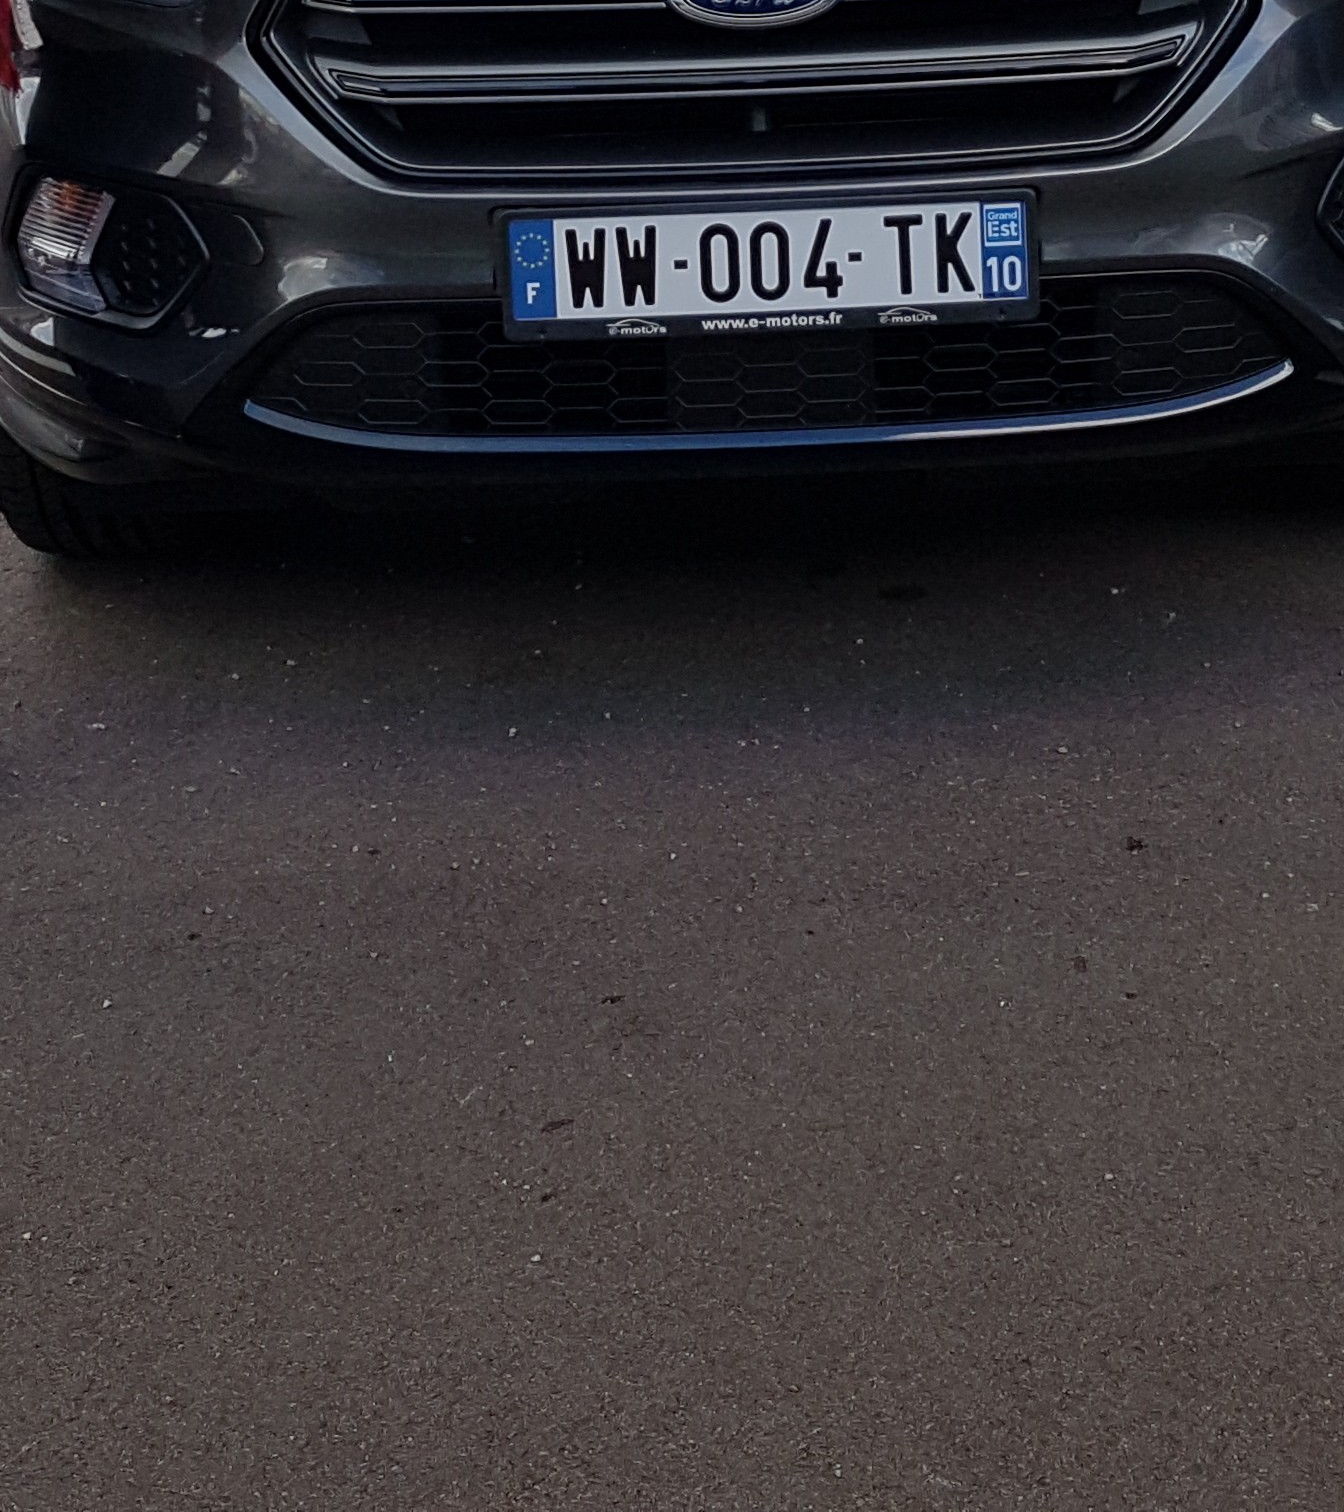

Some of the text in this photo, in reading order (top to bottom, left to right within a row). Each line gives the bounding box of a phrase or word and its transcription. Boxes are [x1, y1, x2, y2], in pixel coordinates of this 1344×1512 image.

[987, 210, 1018, 221] Grand
[987, 220, 1018, 238] Est
[986, 255, 1022, 293] 10
[526, 282, 540, 305] F
[701, 312, 843, 331] www.e-motors.fr
